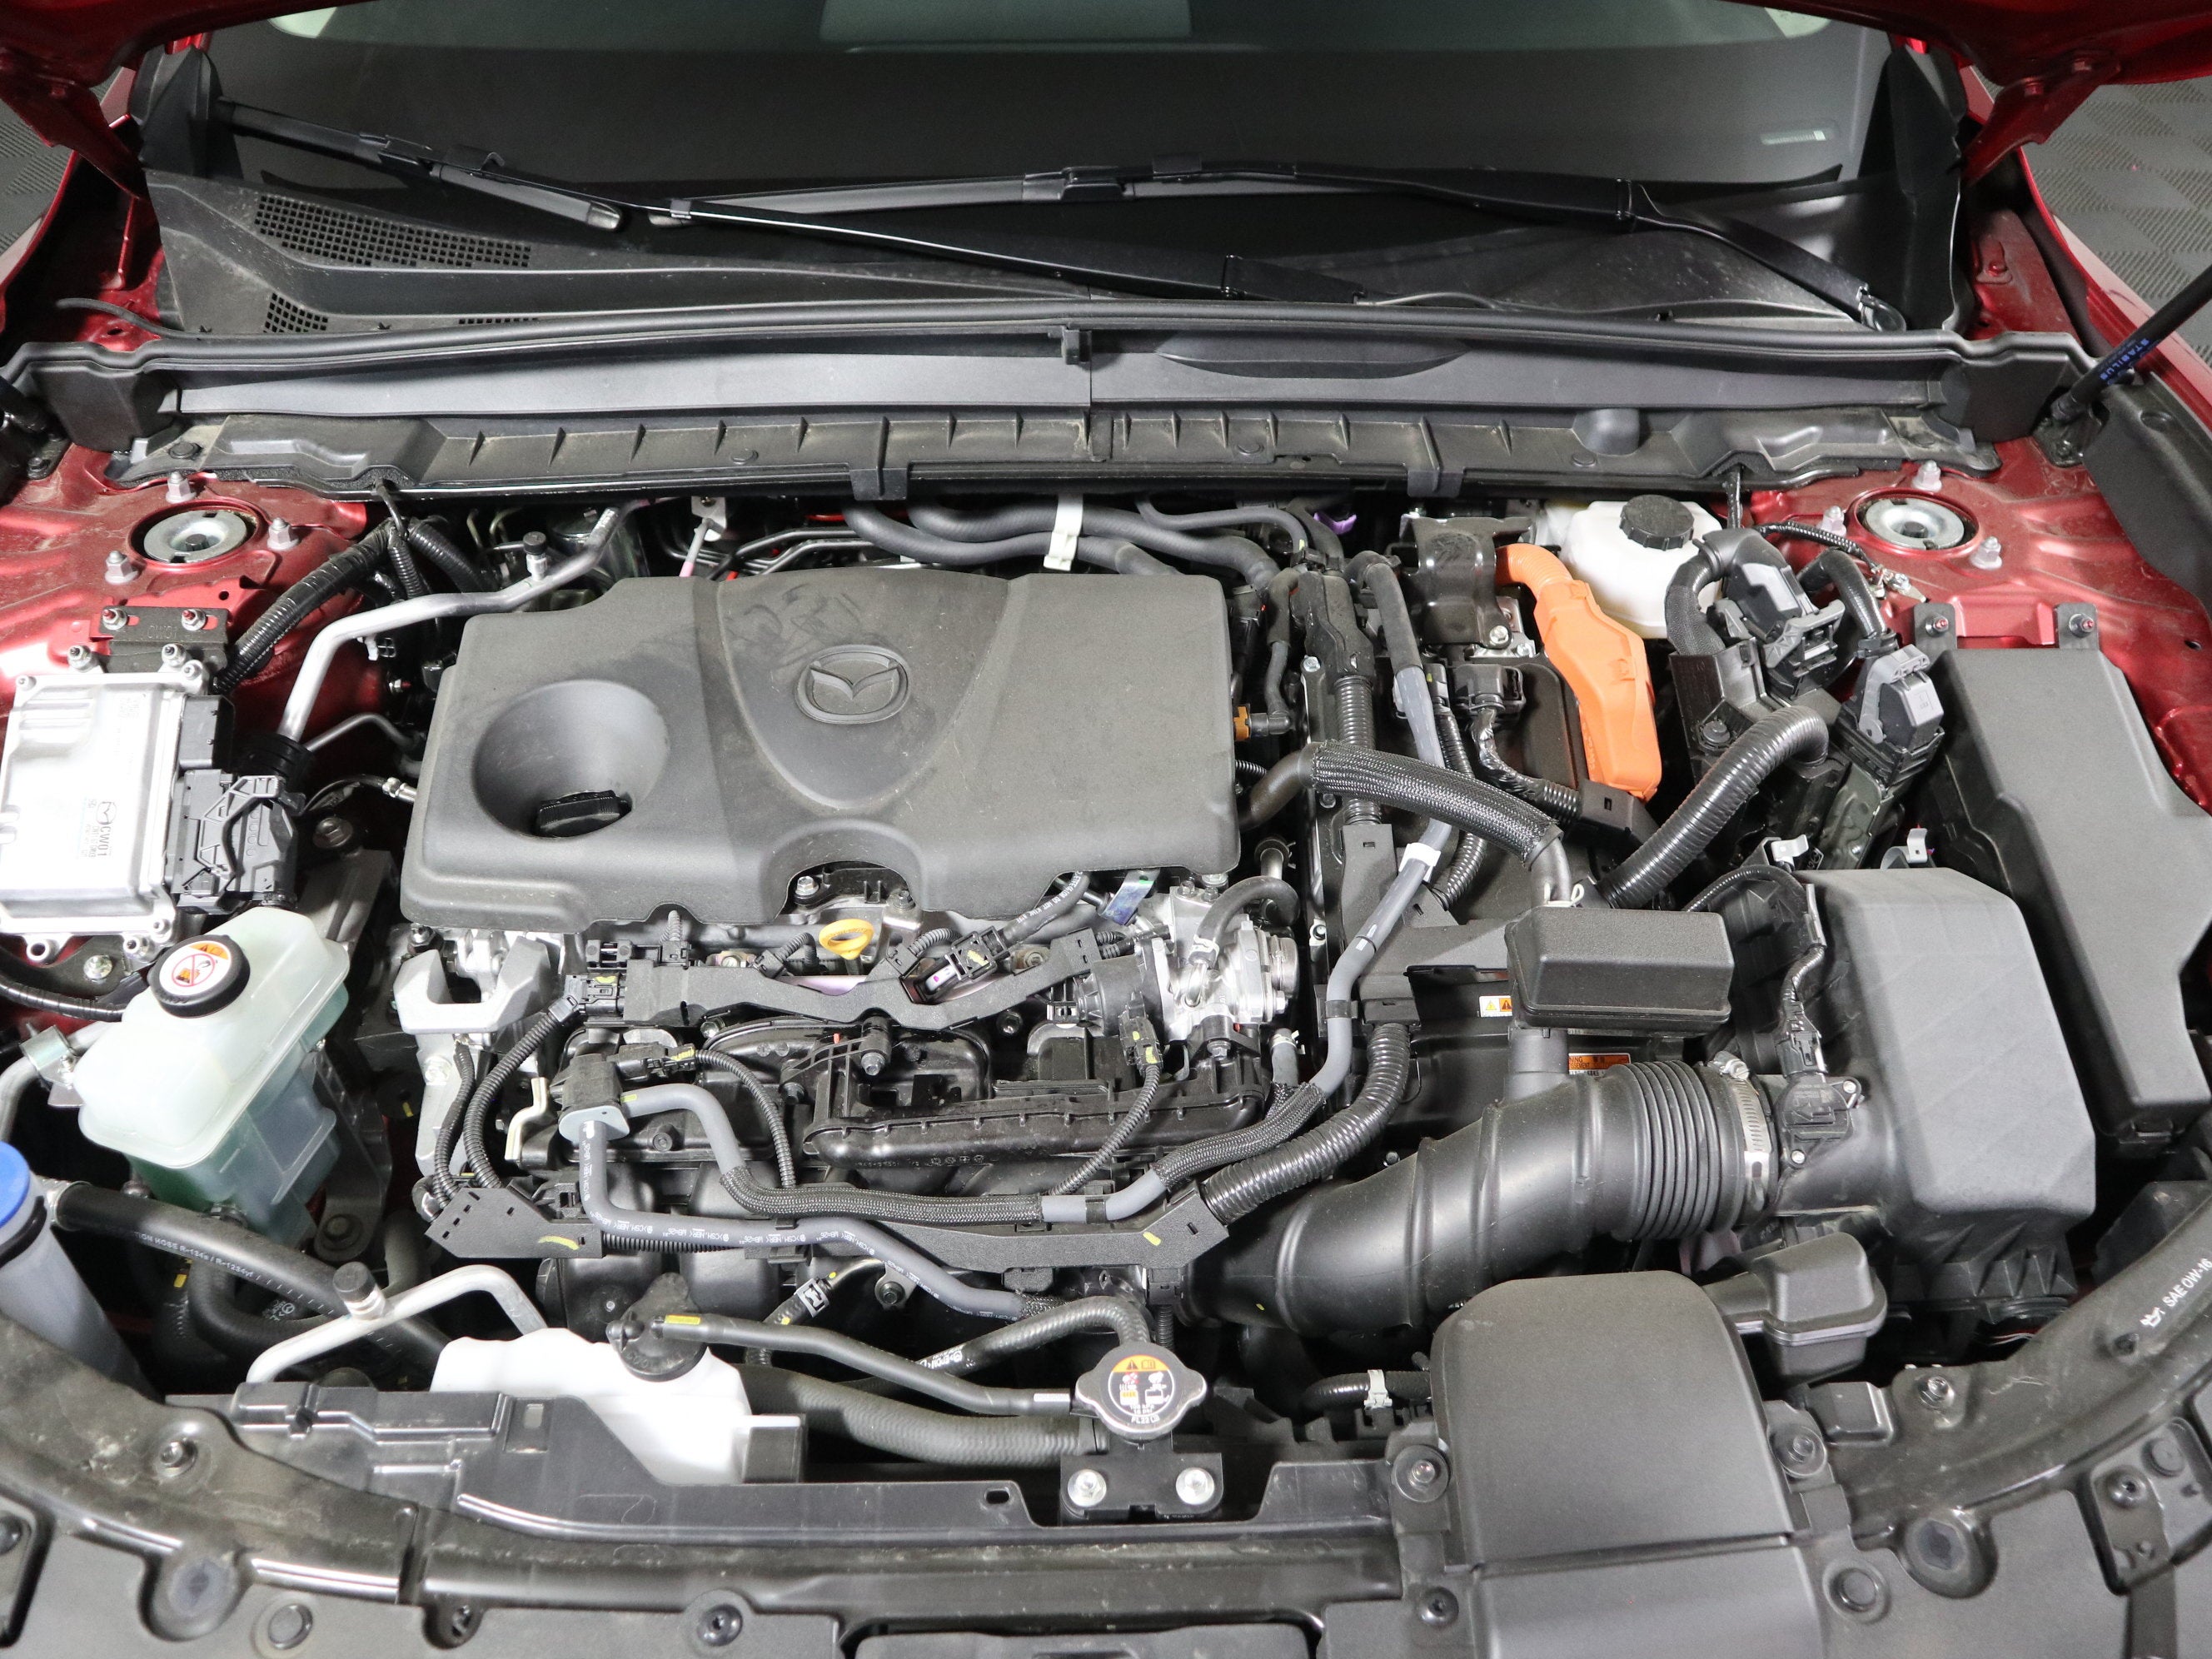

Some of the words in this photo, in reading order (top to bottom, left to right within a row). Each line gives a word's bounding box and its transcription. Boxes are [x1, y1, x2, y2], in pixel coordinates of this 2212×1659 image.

[2100, 338, 2150, 380] STABILUS
[97, 826, 112, 856] CW01
[154, 1237, 179, 1250] HOSE
[215, 1258, 254, 1278] R-1234yf
[2161, 1284, 2188, 1307] SAE
[2180, 1258, 2212, 1288] 0W-16
[1131, 1416, 1150, 1424] FL22
